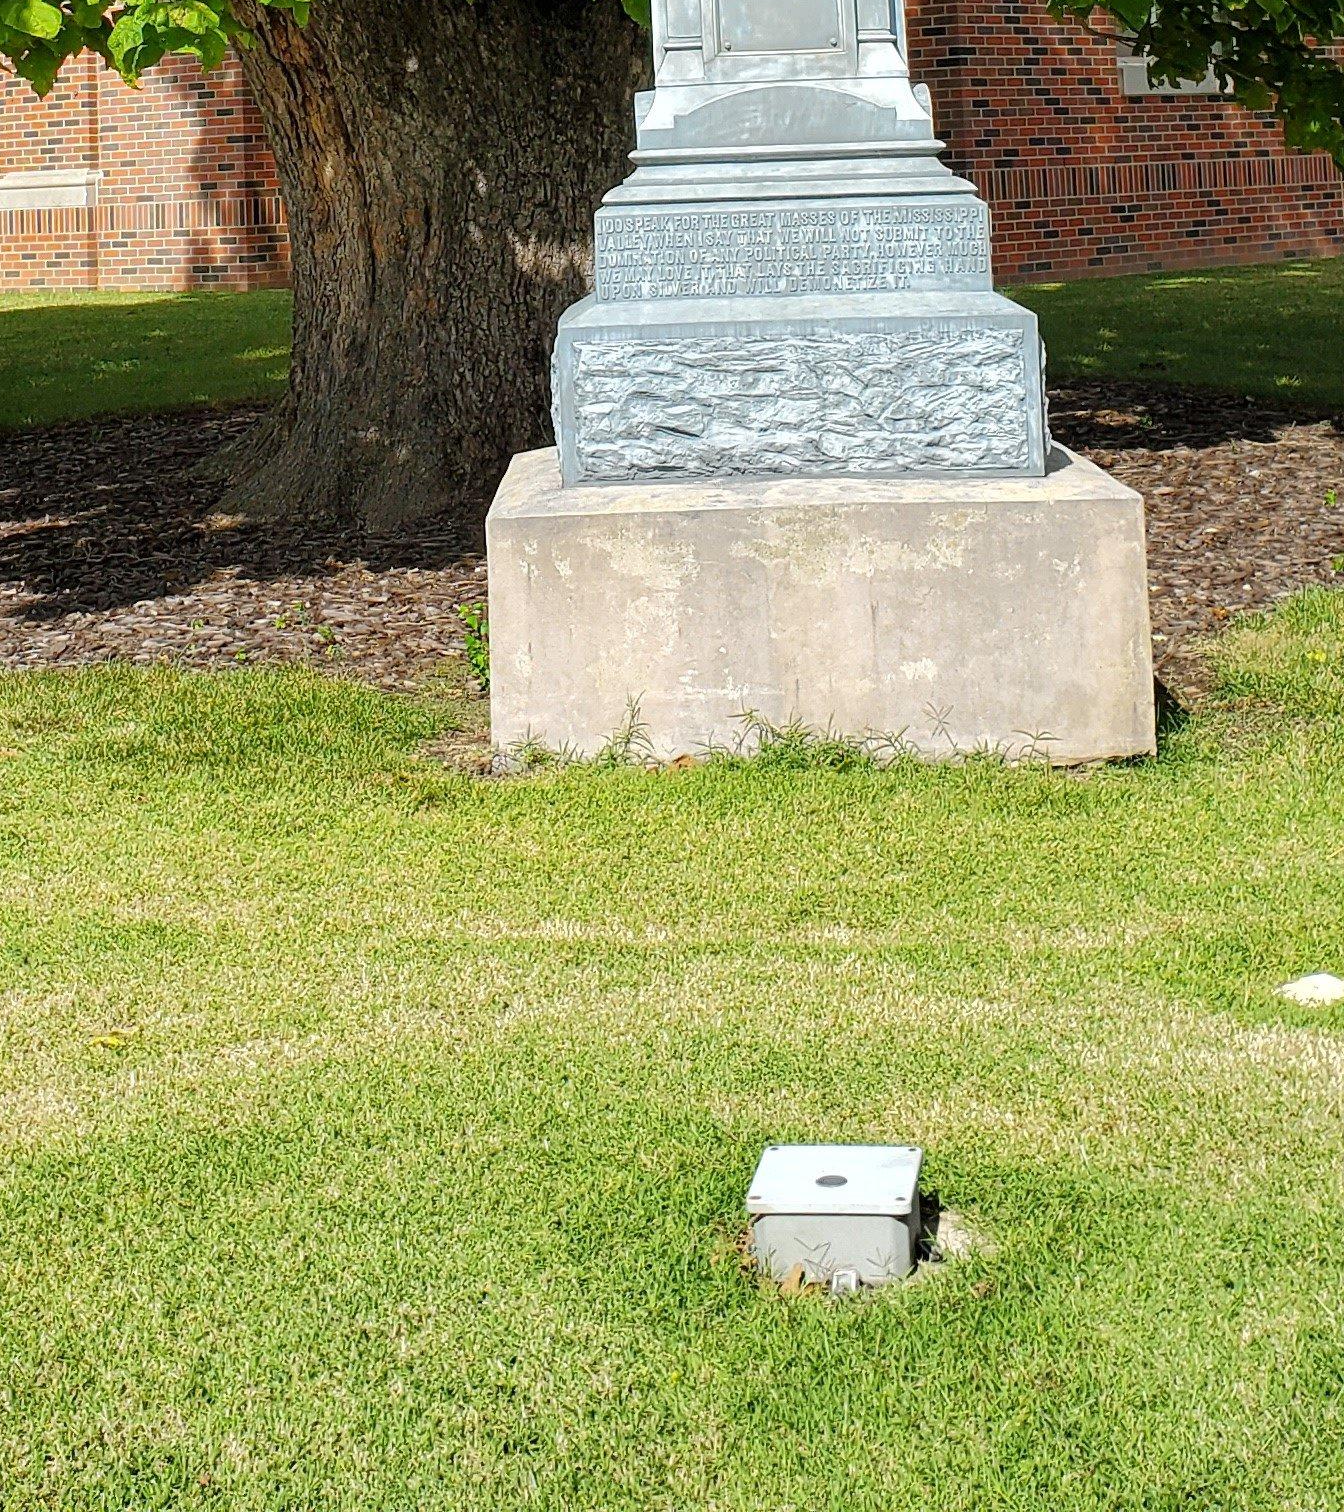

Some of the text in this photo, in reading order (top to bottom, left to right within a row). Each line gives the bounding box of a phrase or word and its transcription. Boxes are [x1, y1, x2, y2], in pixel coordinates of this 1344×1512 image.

[605, 218, 623, 234] DO
[625, 216, 671, 233] SPEAK
[674, 215, 700, 231] FOR
[702, 214, 728, 229] THE
[731, 212, 774, 228] GREAT
[780, 211, 836, 227] MASSES
[840, 210, 858, 226] OF
[863, 209, 890, 225] THE
[893, 207, 984, 224] MISSISSIPPI
[653, 232, 694, 249] WHEN
[705, 230, 732, 246] SAY
[737, 230, 773, 245] THAT
[778, 229, 800, 244] WE
[801, 228, 836, 243] WILL
[842, 228, 870, 243] NOT
[875, 226, 929, 242] SUBMIT
[934, 226, 954, 241] TO
[957, 226, 985, 240] THE
[689, 249, 707, 264] OF
[711, 248, 740, 264] ANY
[744, 245, 817, 262] POLITICAL
[877, 243, 943, 258] HOWEVER
[947, 241, 987, 257] MUCH
[599, 268, 621, 284] WE
[624, 267, 653, 283] MAY
[658, 266, 692, 282] LOVE
[716, 263, 752, 279] THAT
[756, 262, 792, 278] LAYS
[796, 261, 826, 277] THE
[832, 259, 936, 276] SACRIFICING
[943, 258, 987, 274] HAND
[600, 284, 642, 300] UPON
[649, 282, 700, 297] SILVER
[706, 280, 737, 295] AND
[744, 279, 781, 294] WILL
[789, 275, 887, 292] DEMONETIZE
